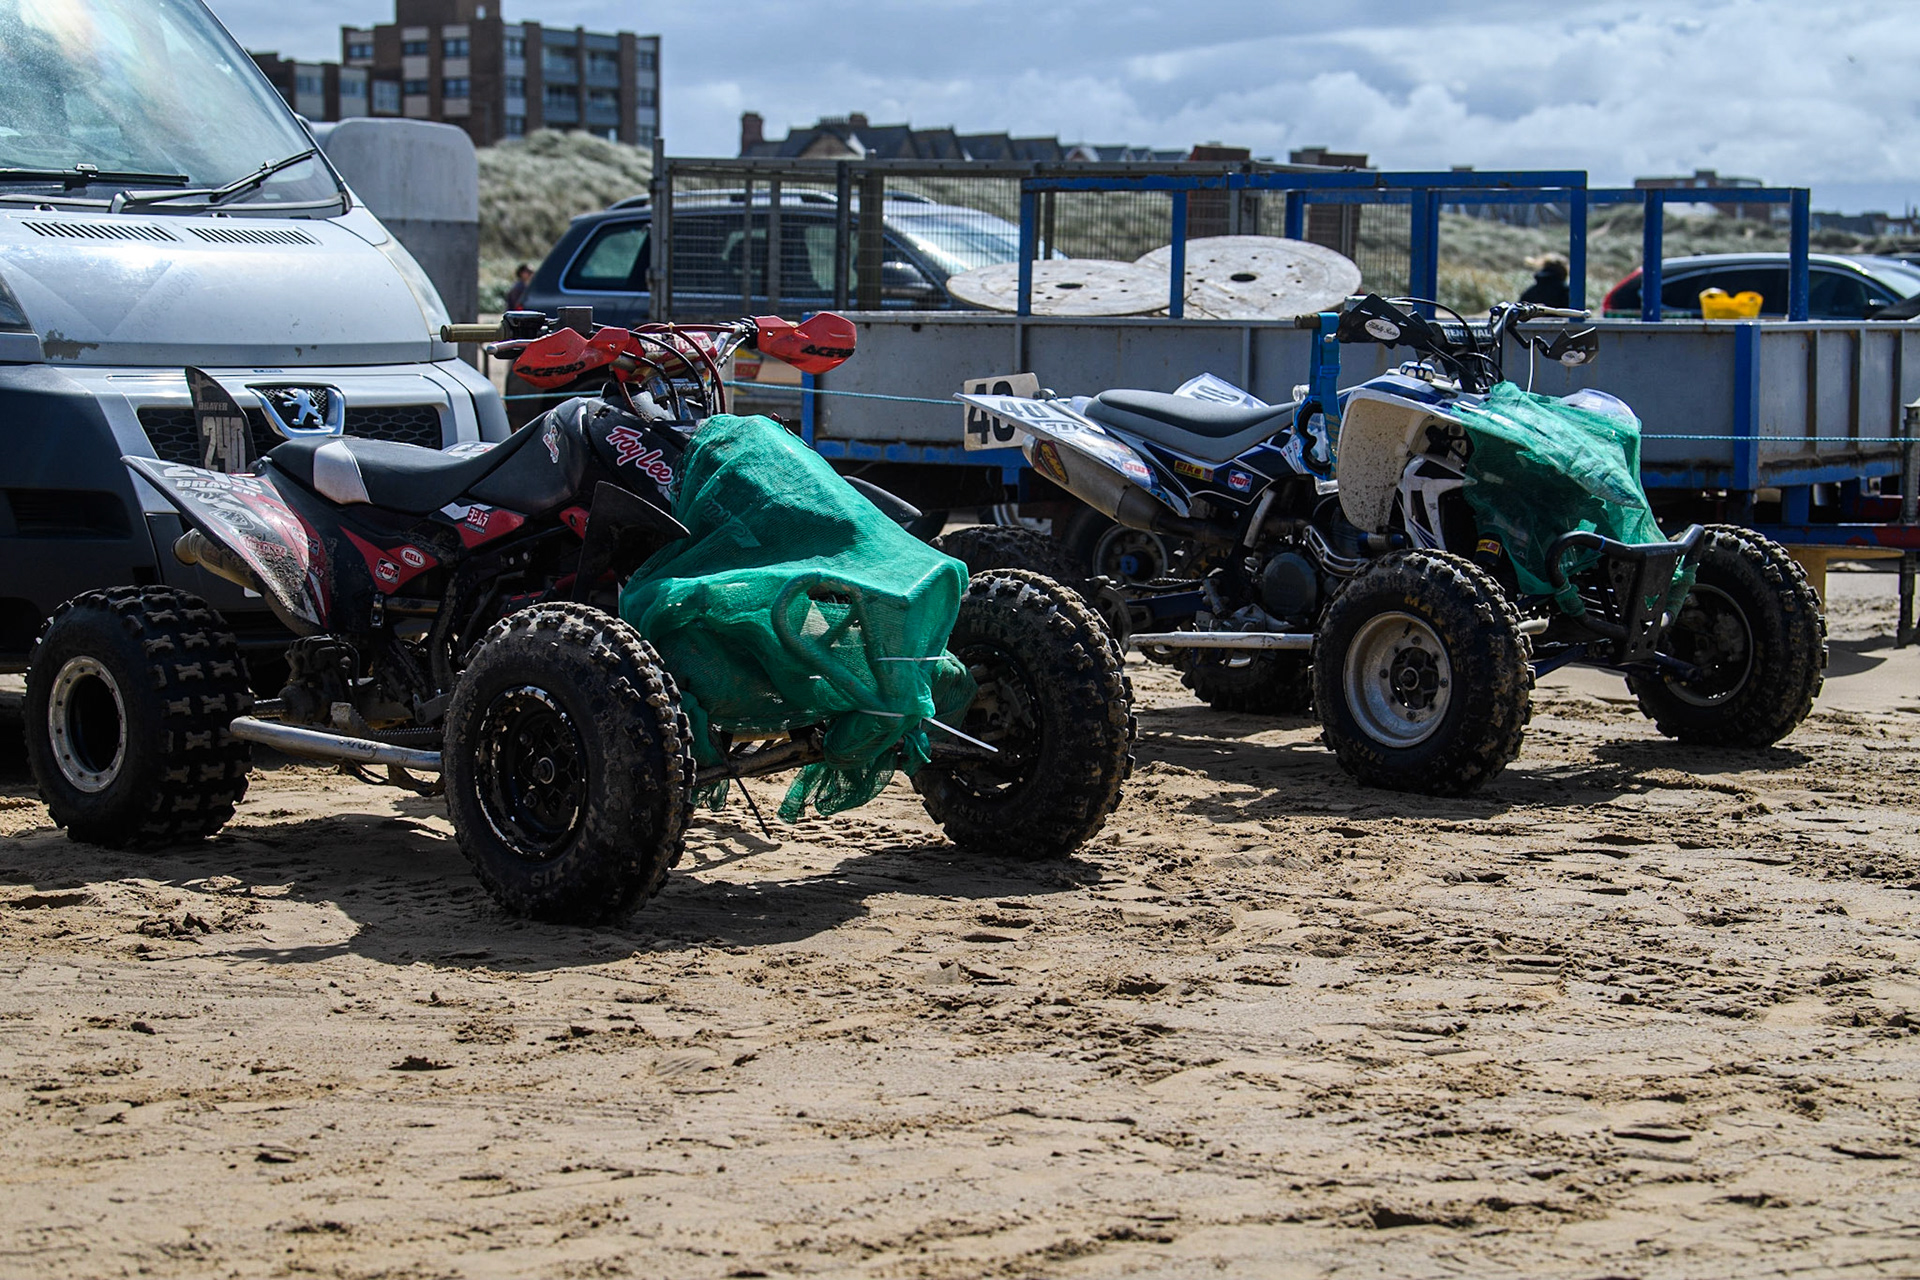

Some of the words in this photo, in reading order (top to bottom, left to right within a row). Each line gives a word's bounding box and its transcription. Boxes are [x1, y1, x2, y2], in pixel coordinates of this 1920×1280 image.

[967, 380, 1017, 445] 40
[1000, 401, 1050, 419] 40
[606, 425, 647, 466] Troy
[635, 449, 674, 486] Lee
[1229, 475, 1250, 487] DWT
[404, 551, 422, 565] BELL
